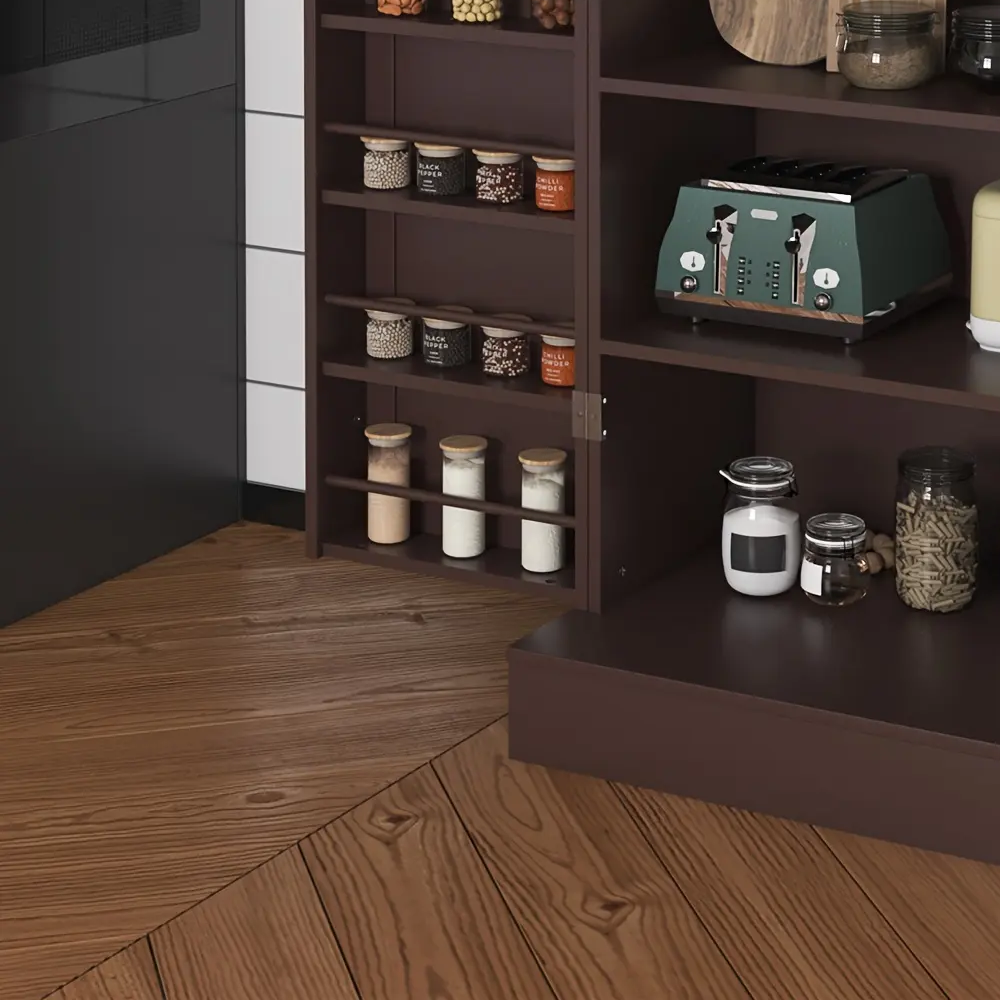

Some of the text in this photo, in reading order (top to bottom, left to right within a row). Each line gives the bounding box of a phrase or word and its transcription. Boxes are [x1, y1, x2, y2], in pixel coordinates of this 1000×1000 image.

[419, 163, 440, 171] BLACK
[417, 169, 443, 178] PEPPER
[537, 176, 559, 185] CHILLI
[425, 333, 446, 342] BLACK
[423, 340, 449, 349] PEPPER
[543, 351, 565, 360] CHILLI
